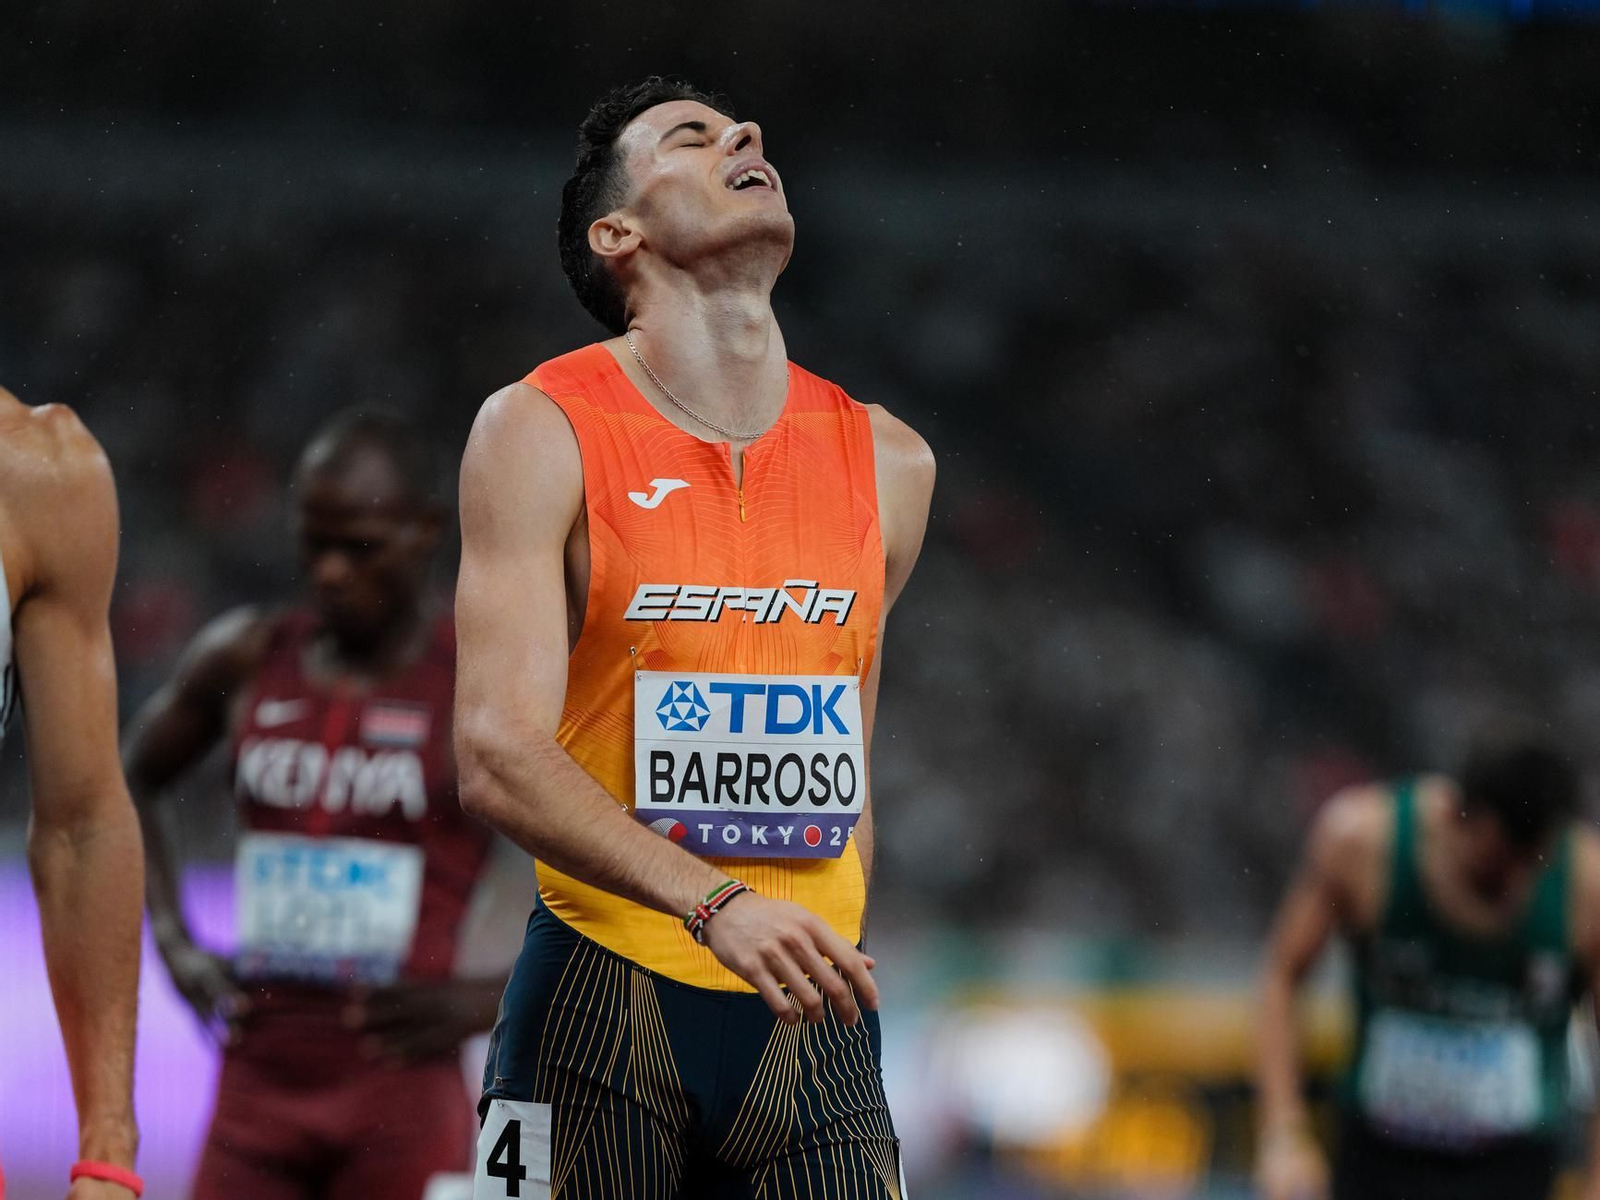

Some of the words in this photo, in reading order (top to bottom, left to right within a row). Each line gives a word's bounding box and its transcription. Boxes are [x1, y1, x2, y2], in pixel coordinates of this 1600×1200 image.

[623, 579, 857, 626] ESPAÑA
[709, 682, 851, 735] TDK
[650, 750, 856, 807] BARROSO
[486, 1118, 527, 1198] 4
